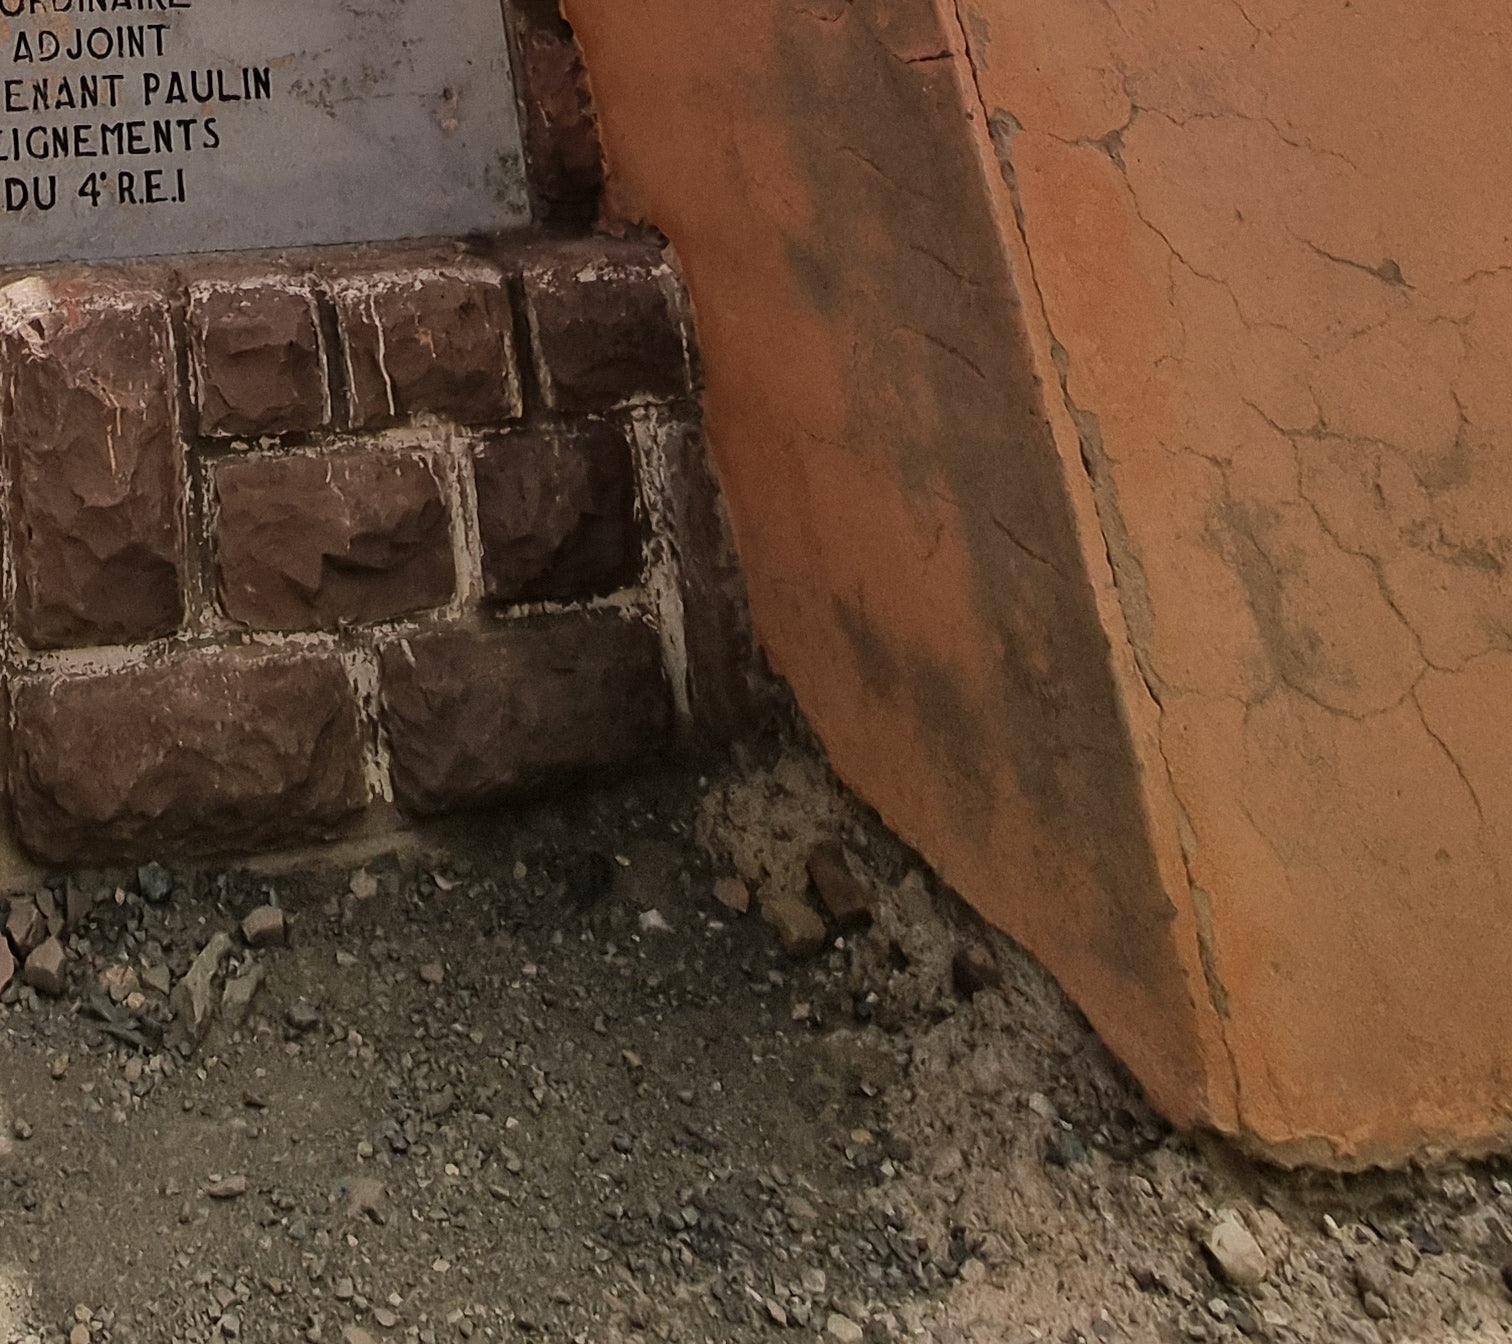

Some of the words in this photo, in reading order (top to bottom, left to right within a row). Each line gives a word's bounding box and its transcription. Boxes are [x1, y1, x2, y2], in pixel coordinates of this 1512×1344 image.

[13, 24, 170, 63] ADJOINT
[143, 67, 270, 106] PAULIN
[5, 176, 56, 211] DU
